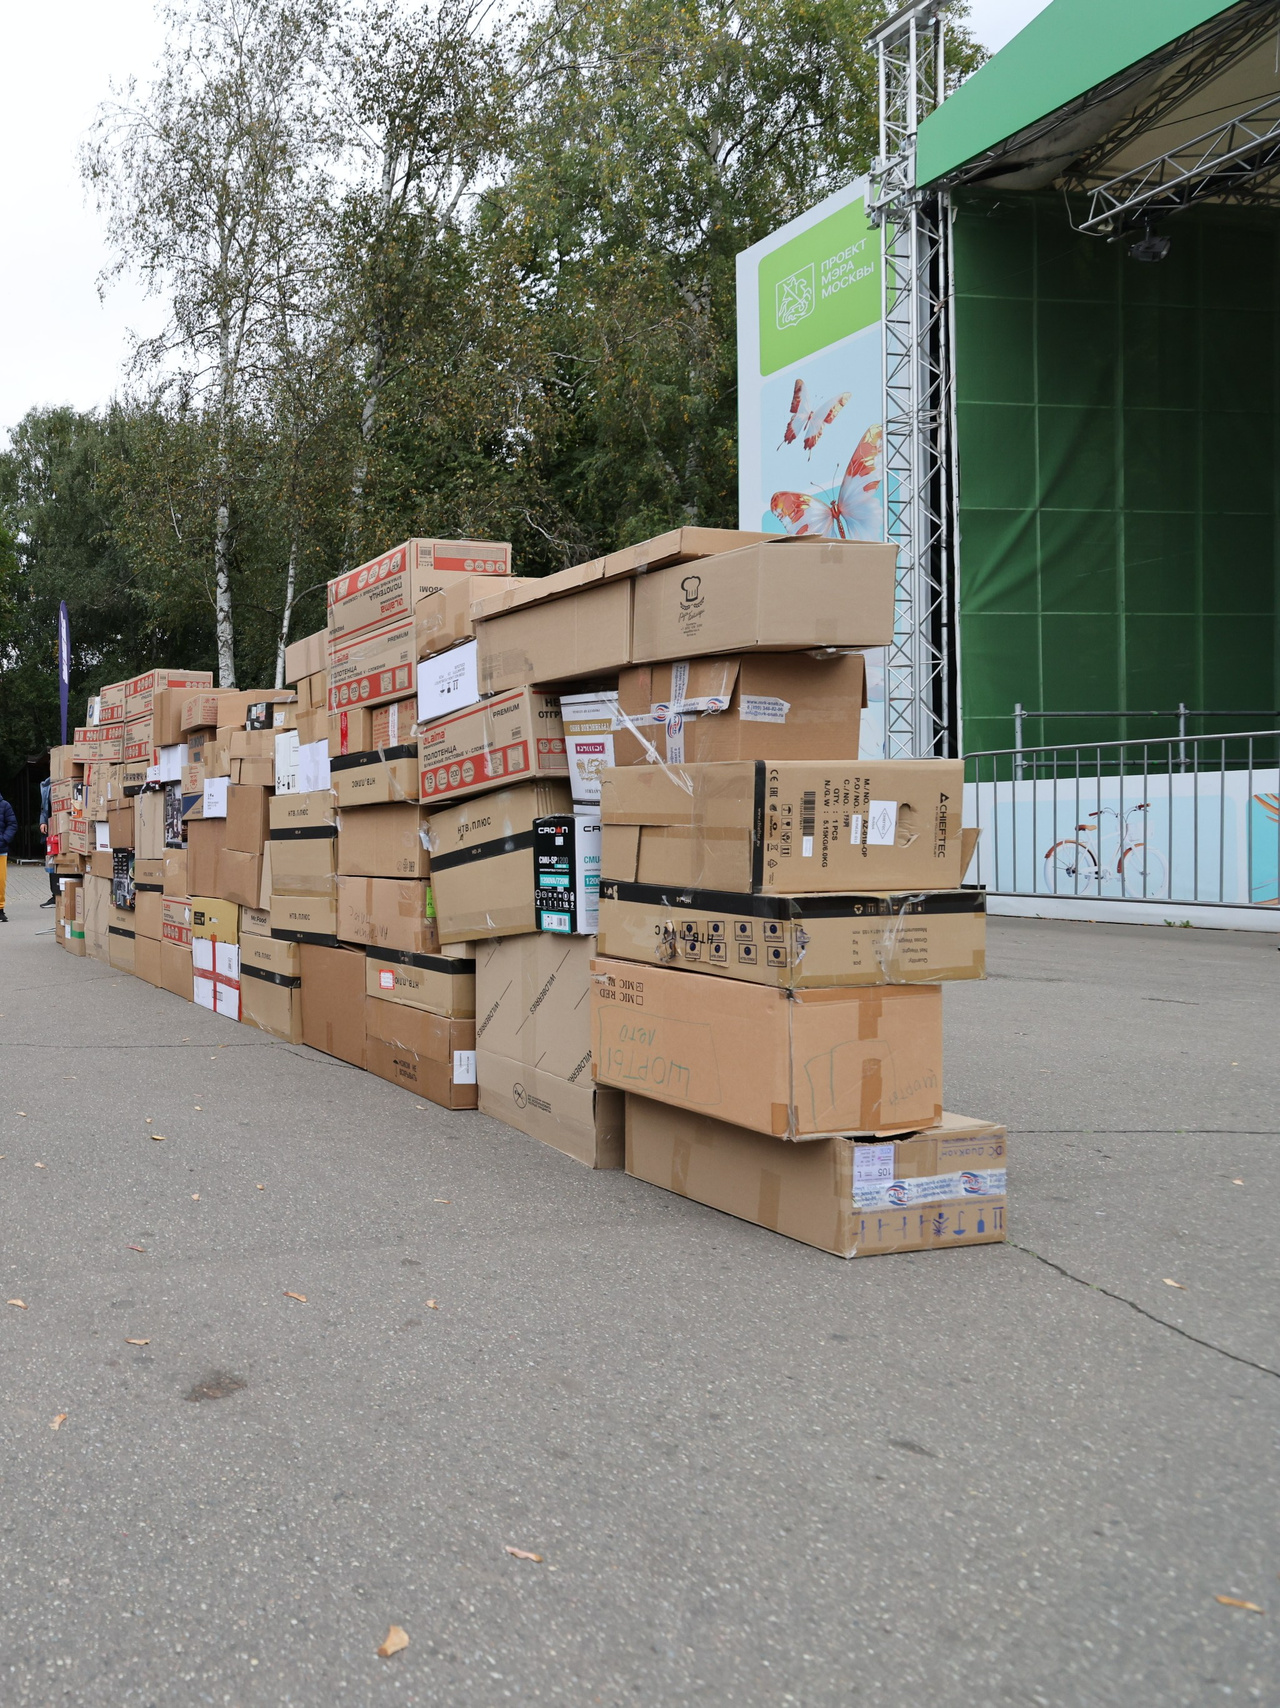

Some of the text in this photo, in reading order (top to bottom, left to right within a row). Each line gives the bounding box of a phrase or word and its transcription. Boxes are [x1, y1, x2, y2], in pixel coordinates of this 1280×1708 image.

[821, 238, 867, 273] ПРОЕКТ
[821, 261, 855, 286] МЭРА
[821, 262, 875, 299] МОСКВЫ
[369, 582, 403, 601] ПОЛОТЕНЦА
[387, 631, 409, 643] PREMIUM
[492, 703, 520, 719] PREMIUM
[423, 745, 458, 762] ПОЛОТЕНЦА
[423, 756, 445, 769] БУМАЖНЫЕ
[446, 751, 465, 763] ЛИСТОВЫЕ
[470, 741, 494, 754] СЛОЖЕНИЯ
[426, 774, 434, 785] 15
[450, 768, 460, 778] 200
[821, 819, 830, 868] 5.15KG/6.0KG
[831, 825, 839, 841] PCS
[937, 805, 948, 859] CHIEFTEC
[530, 973, 557, 1015] WILDBERRIES
[600, 988, 635, 1004] MIC RED
[619, 978, 635, 990] MIC
[477, 1001, 501, 1038] WILDBERRIES
[567, 1049, 593, 1083] WILDBERR
[607, 1047, 690, 1097] ШОРТЫ
[877, 1167, 891, 1177] 105
